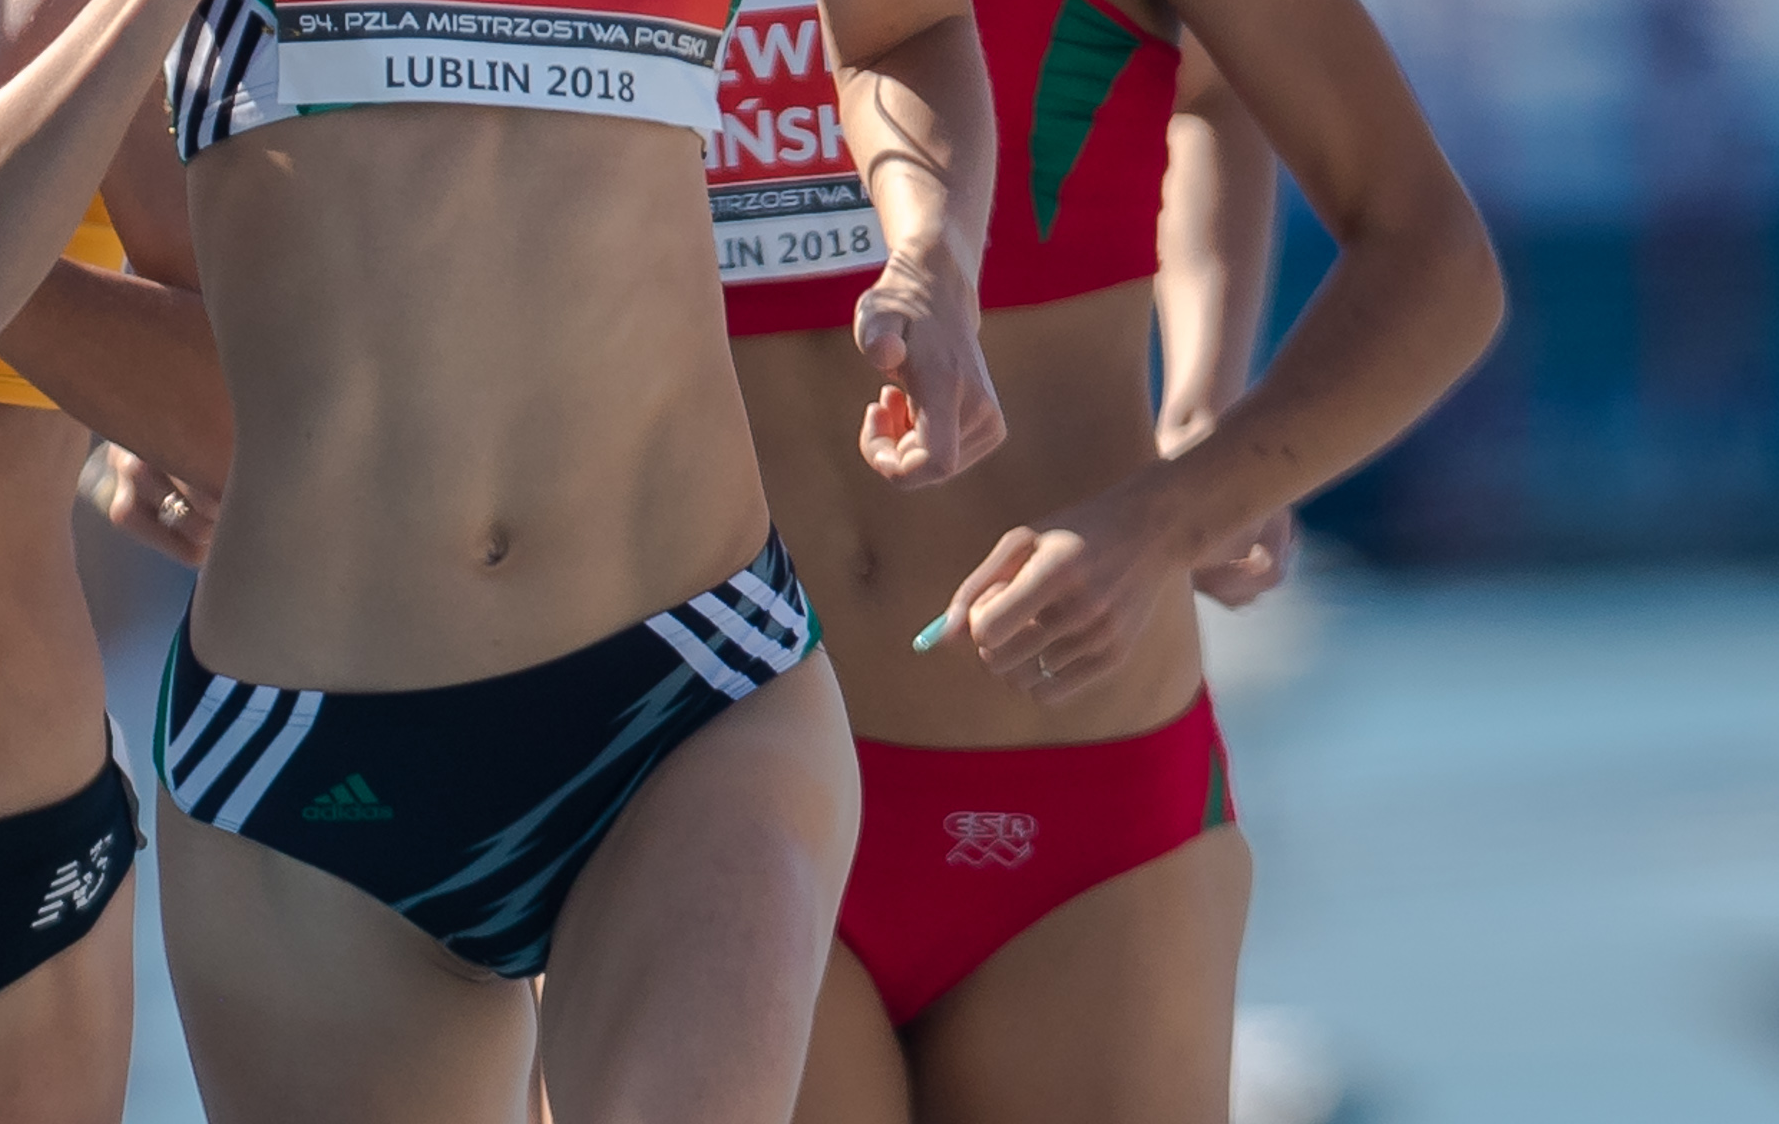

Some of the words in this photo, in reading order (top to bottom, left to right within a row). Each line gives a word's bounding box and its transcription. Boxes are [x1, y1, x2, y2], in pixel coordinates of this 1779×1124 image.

[298, 14, 339, 33] 94.
[345, 11, 420, 31] PZLA
[426, 12, 630, 46] MISTRZOSTWA
[634, 27, 708, 60] POLSKI
[384, 56, 530, 94] LUBLIN
[546, 64, 636, 103] 2018
[777, 224, 872, 264] 2018
[302, 806, 393, 822] adidas
